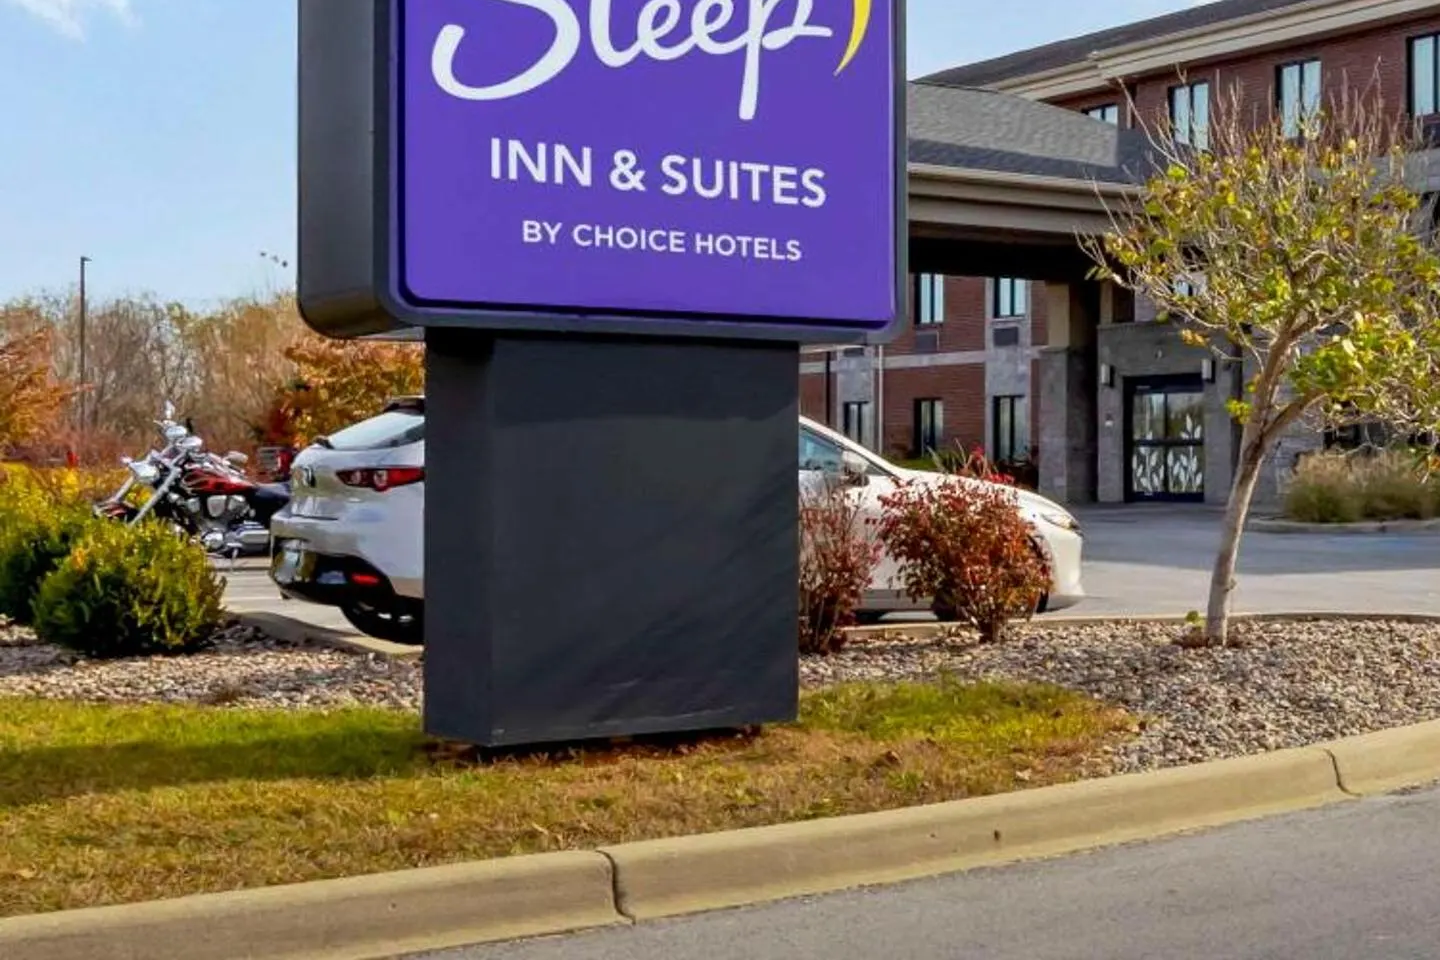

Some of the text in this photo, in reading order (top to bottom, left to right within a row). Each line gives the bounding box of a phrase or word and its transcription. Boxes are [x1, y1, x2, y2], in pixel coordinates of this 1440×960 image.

[491, 137, 827, 208] INN & SUITES
[522, 220, 802, 261] BY CHOICE HOTELS
